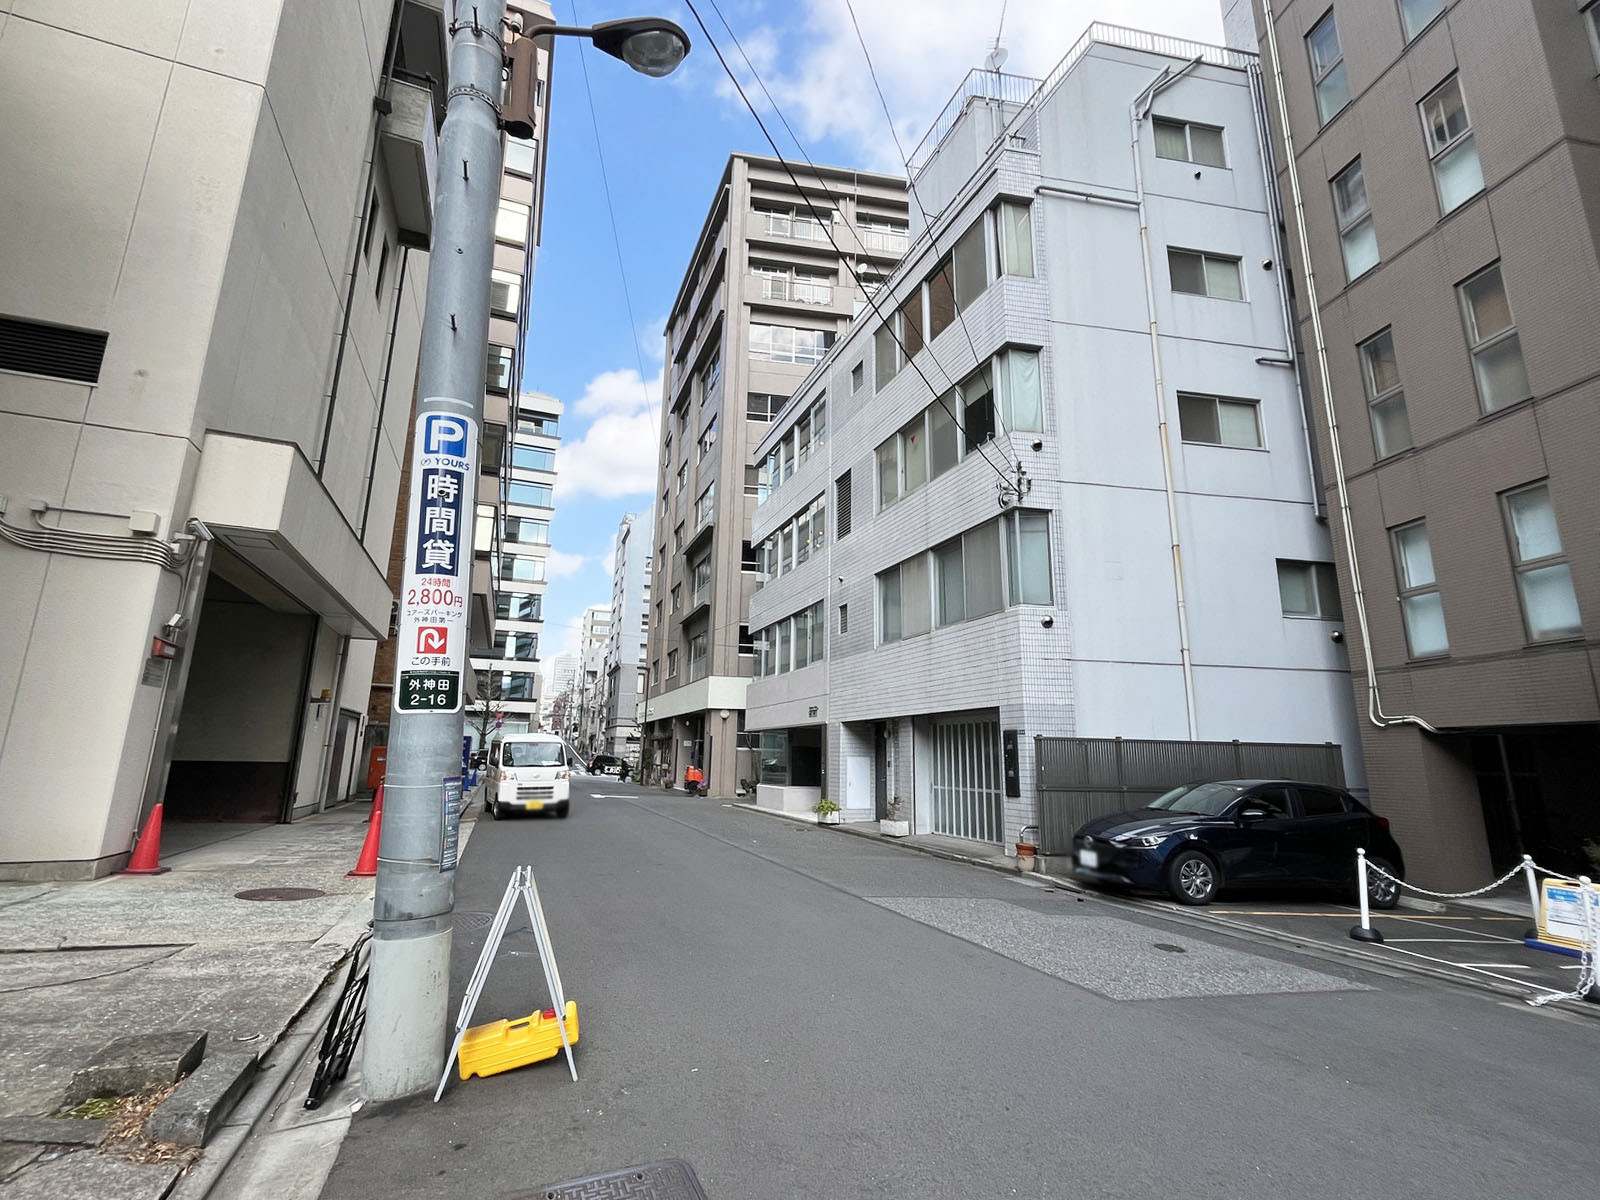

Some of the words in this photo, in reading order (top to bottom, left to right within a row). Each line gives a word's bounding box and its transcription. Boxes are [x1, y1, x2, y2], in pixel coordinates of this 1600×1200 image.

[430, 419, 464, 451] P
[435, 457, 470, 471] YOURS
[422, 474, 453, 569] 時間貸
[421, 577, 451, 588] 24時間
[408, 588, 463, 608] 2,800円
[411, 656, 451, 667] この手前
[408, 678, 450, 691] 外神田
[410, 693, 446, 706] 2-16
